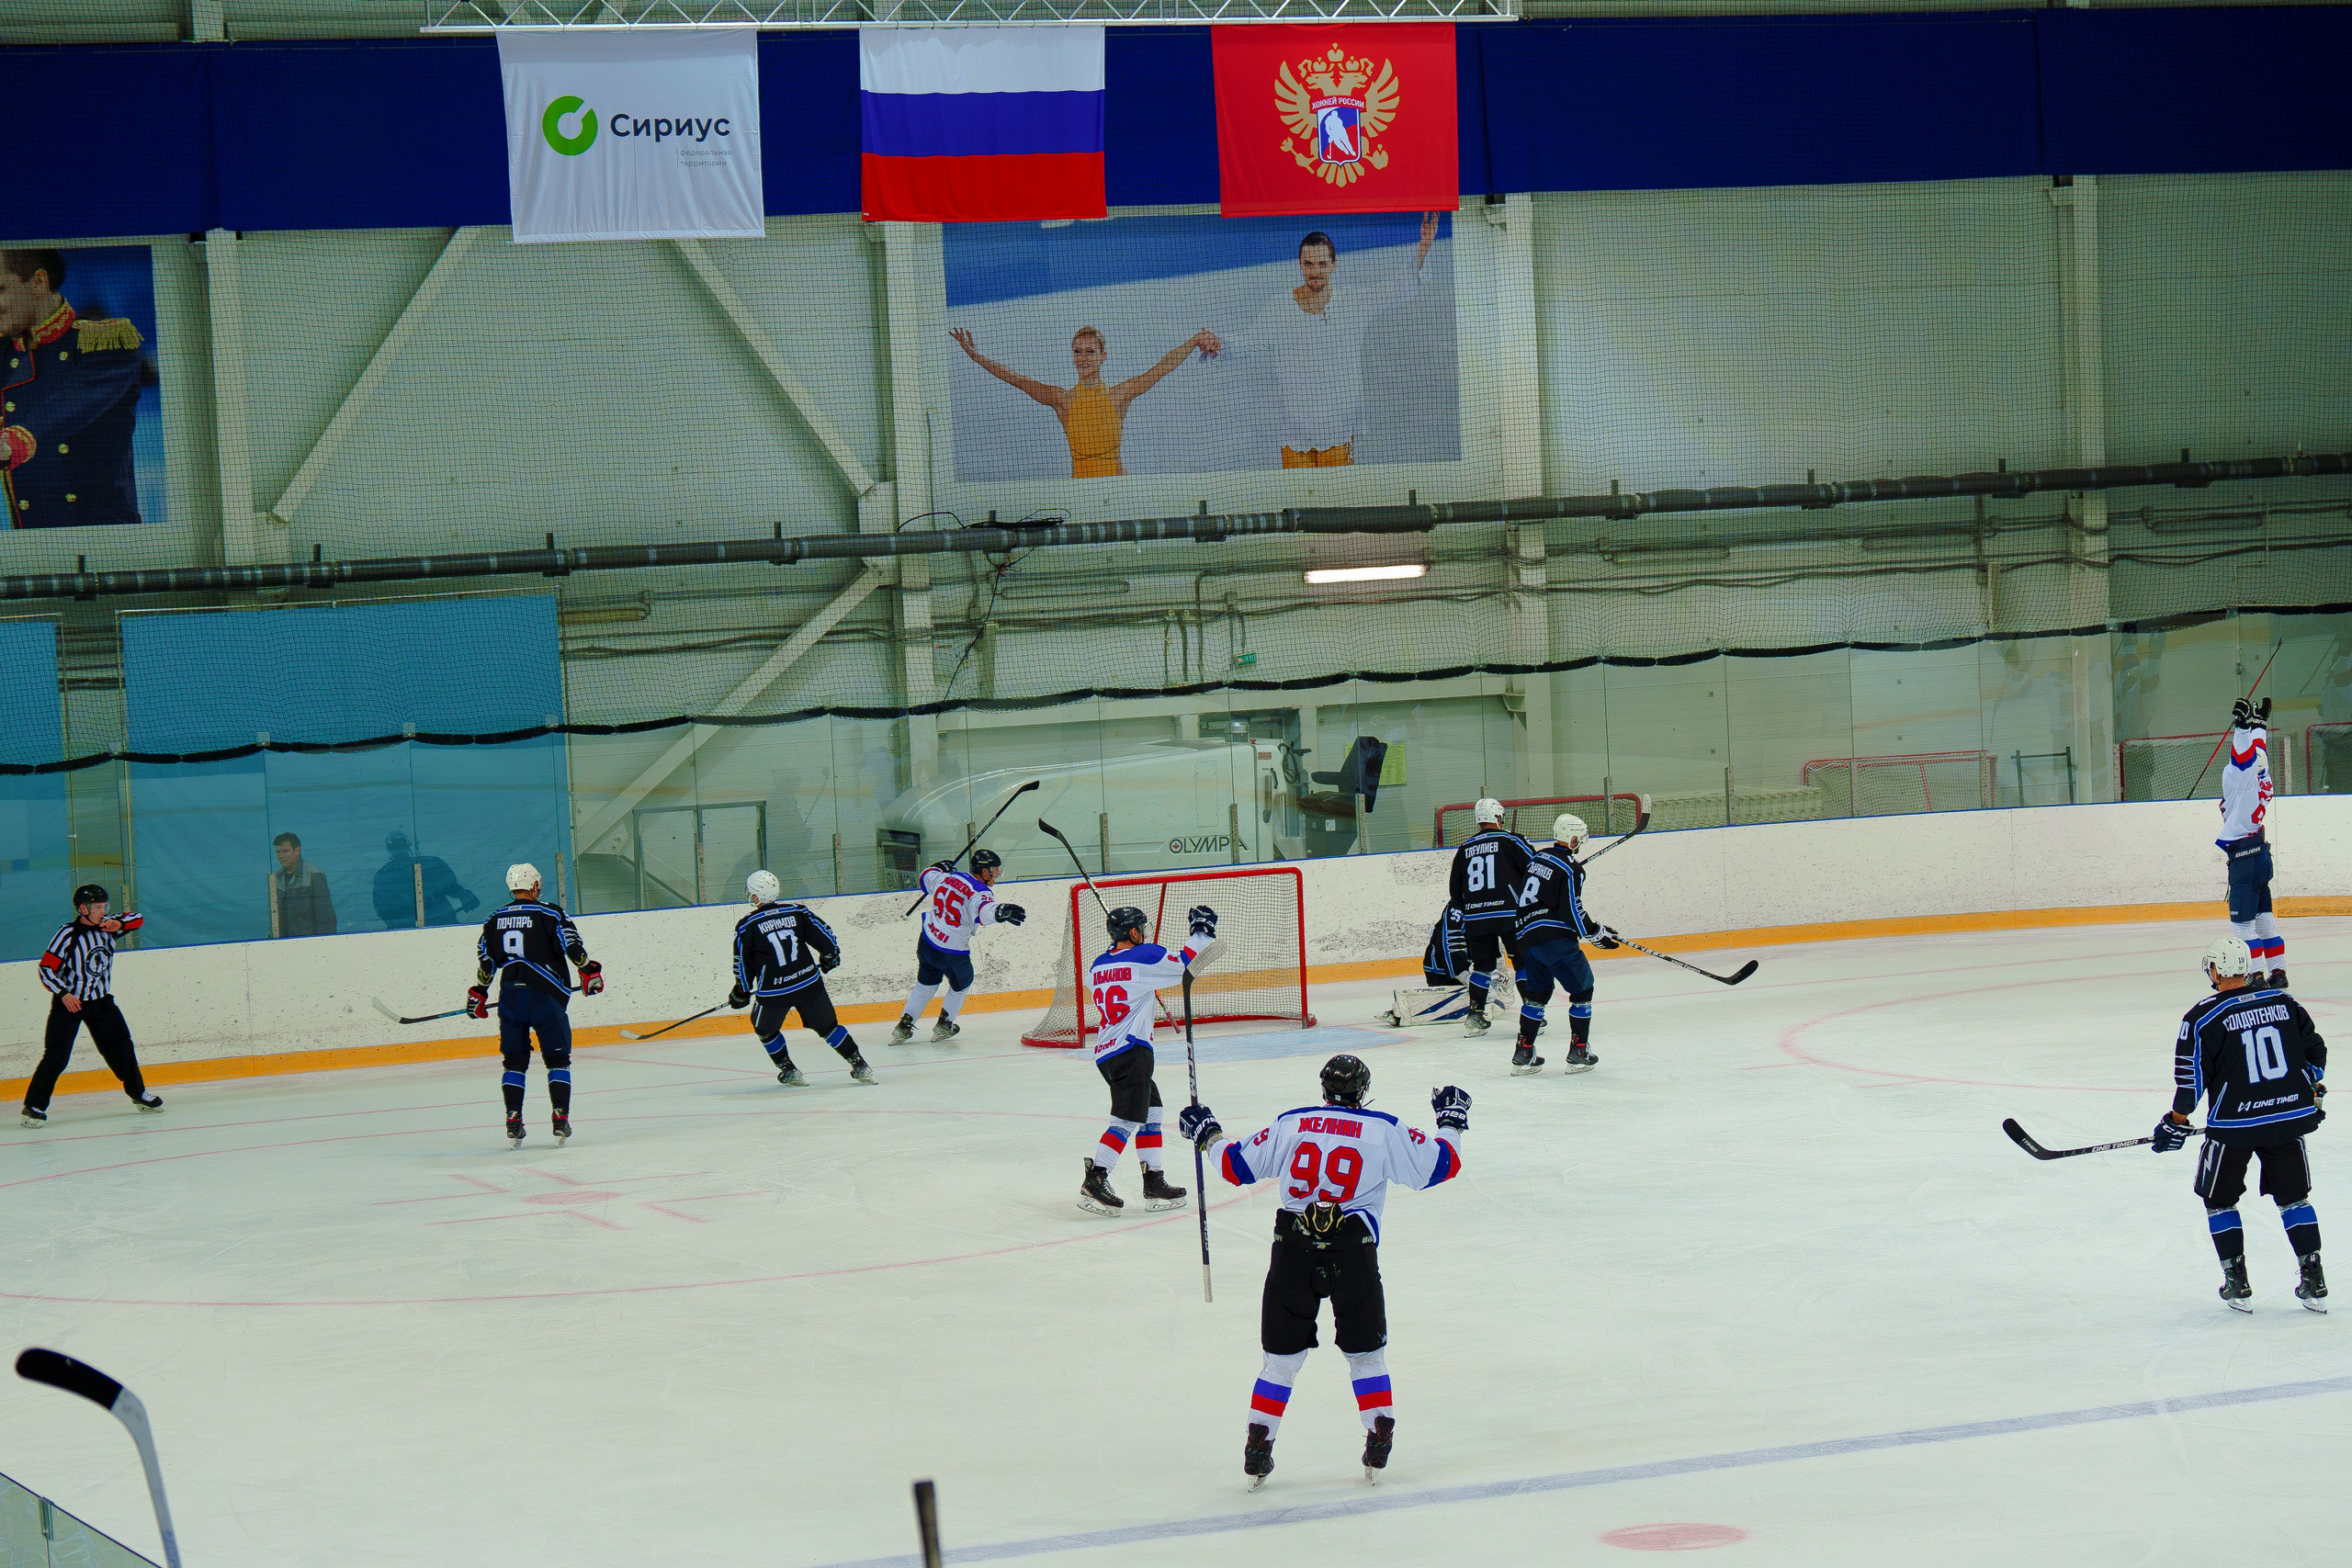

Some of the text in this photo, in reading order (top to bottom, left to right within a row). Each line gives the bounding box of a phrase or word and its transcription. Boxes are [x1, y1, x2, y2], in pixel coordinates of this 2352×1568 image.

[1311, 96, 1364, 110] ХОККЕЙ РОССИИ
[610, 113, 730, 142] Сириус
[679, 149, 731, 157] федеральная
[1169, 835, 1250, 854] OLYMPA
[2234, 846, 2261, 858] BAUER
[1467, 854, 1496, 892] 81
[497, 916, 533, 930] ПОЧТАРЬ
[758, 915, 797, 934] КАРИМОВ
[503, 930, 525, 958] 9
[766, 929, 799, 967] 17
[1092, 985, 1130, 1029] 66
[2241, 1025, 2289, 1085] 10
[2253, 1093, 2299, 1110] ONE TIMER
[1436, 1109, 1467, 1121] BAUE
[1297, 1116, 1363, 1139] ЖЕЛНИН
[2091, 1139, 2139, 1154] ONE TIMER
[1288, 1141, 1364, 1203] 99
